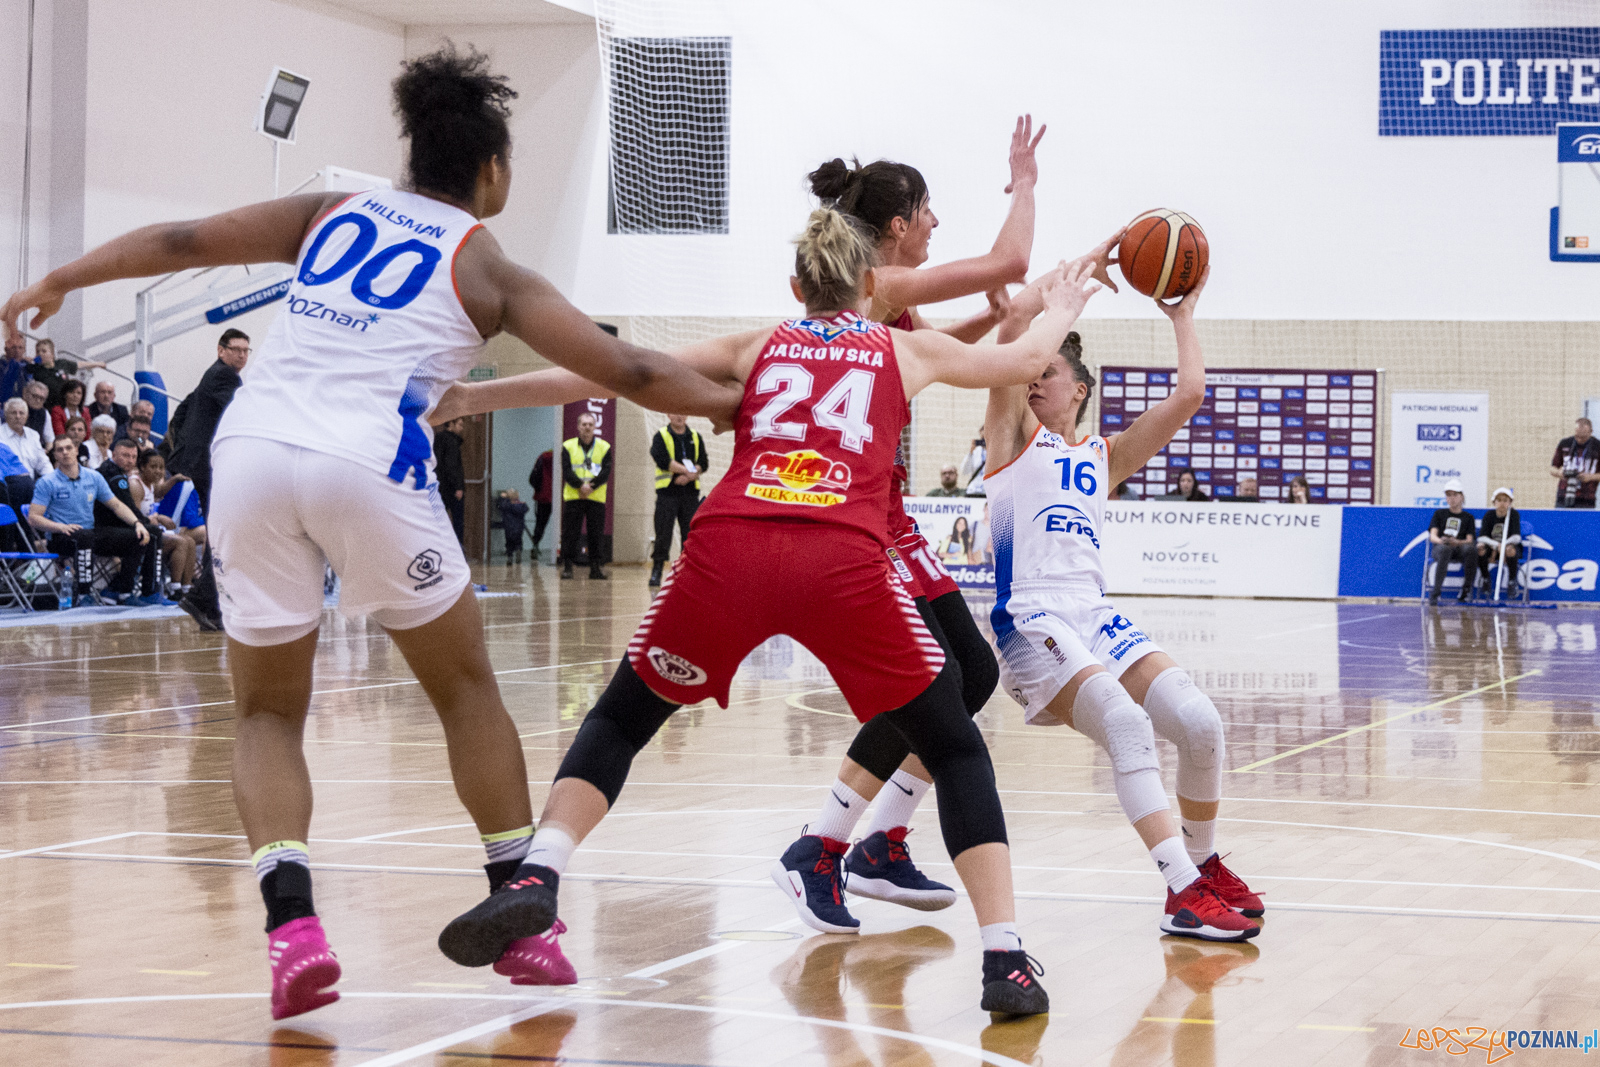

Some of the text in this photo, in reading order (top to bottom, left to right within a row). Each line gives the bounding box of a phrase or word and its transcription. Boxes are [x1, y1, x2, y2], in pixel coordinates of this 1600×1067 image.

[1419, 58, 1600, 105] POLITE
[362, 198, 446, 239] HILLSMAN
[298, 211, 442, 310] 00
[222, 281, 292, 315] PESMENPO
[763, 343, 884, 367] JACKOWSKA
[751, 362, 876, 454] 24
[1054, 457, 1097, 496] 16
[752, 486, 841, 505] PIEKARNIA
[1152, 511, 1321, 528] KONFERENCYJNE
[1142, 551, 1220, 564] NOVOTEL
